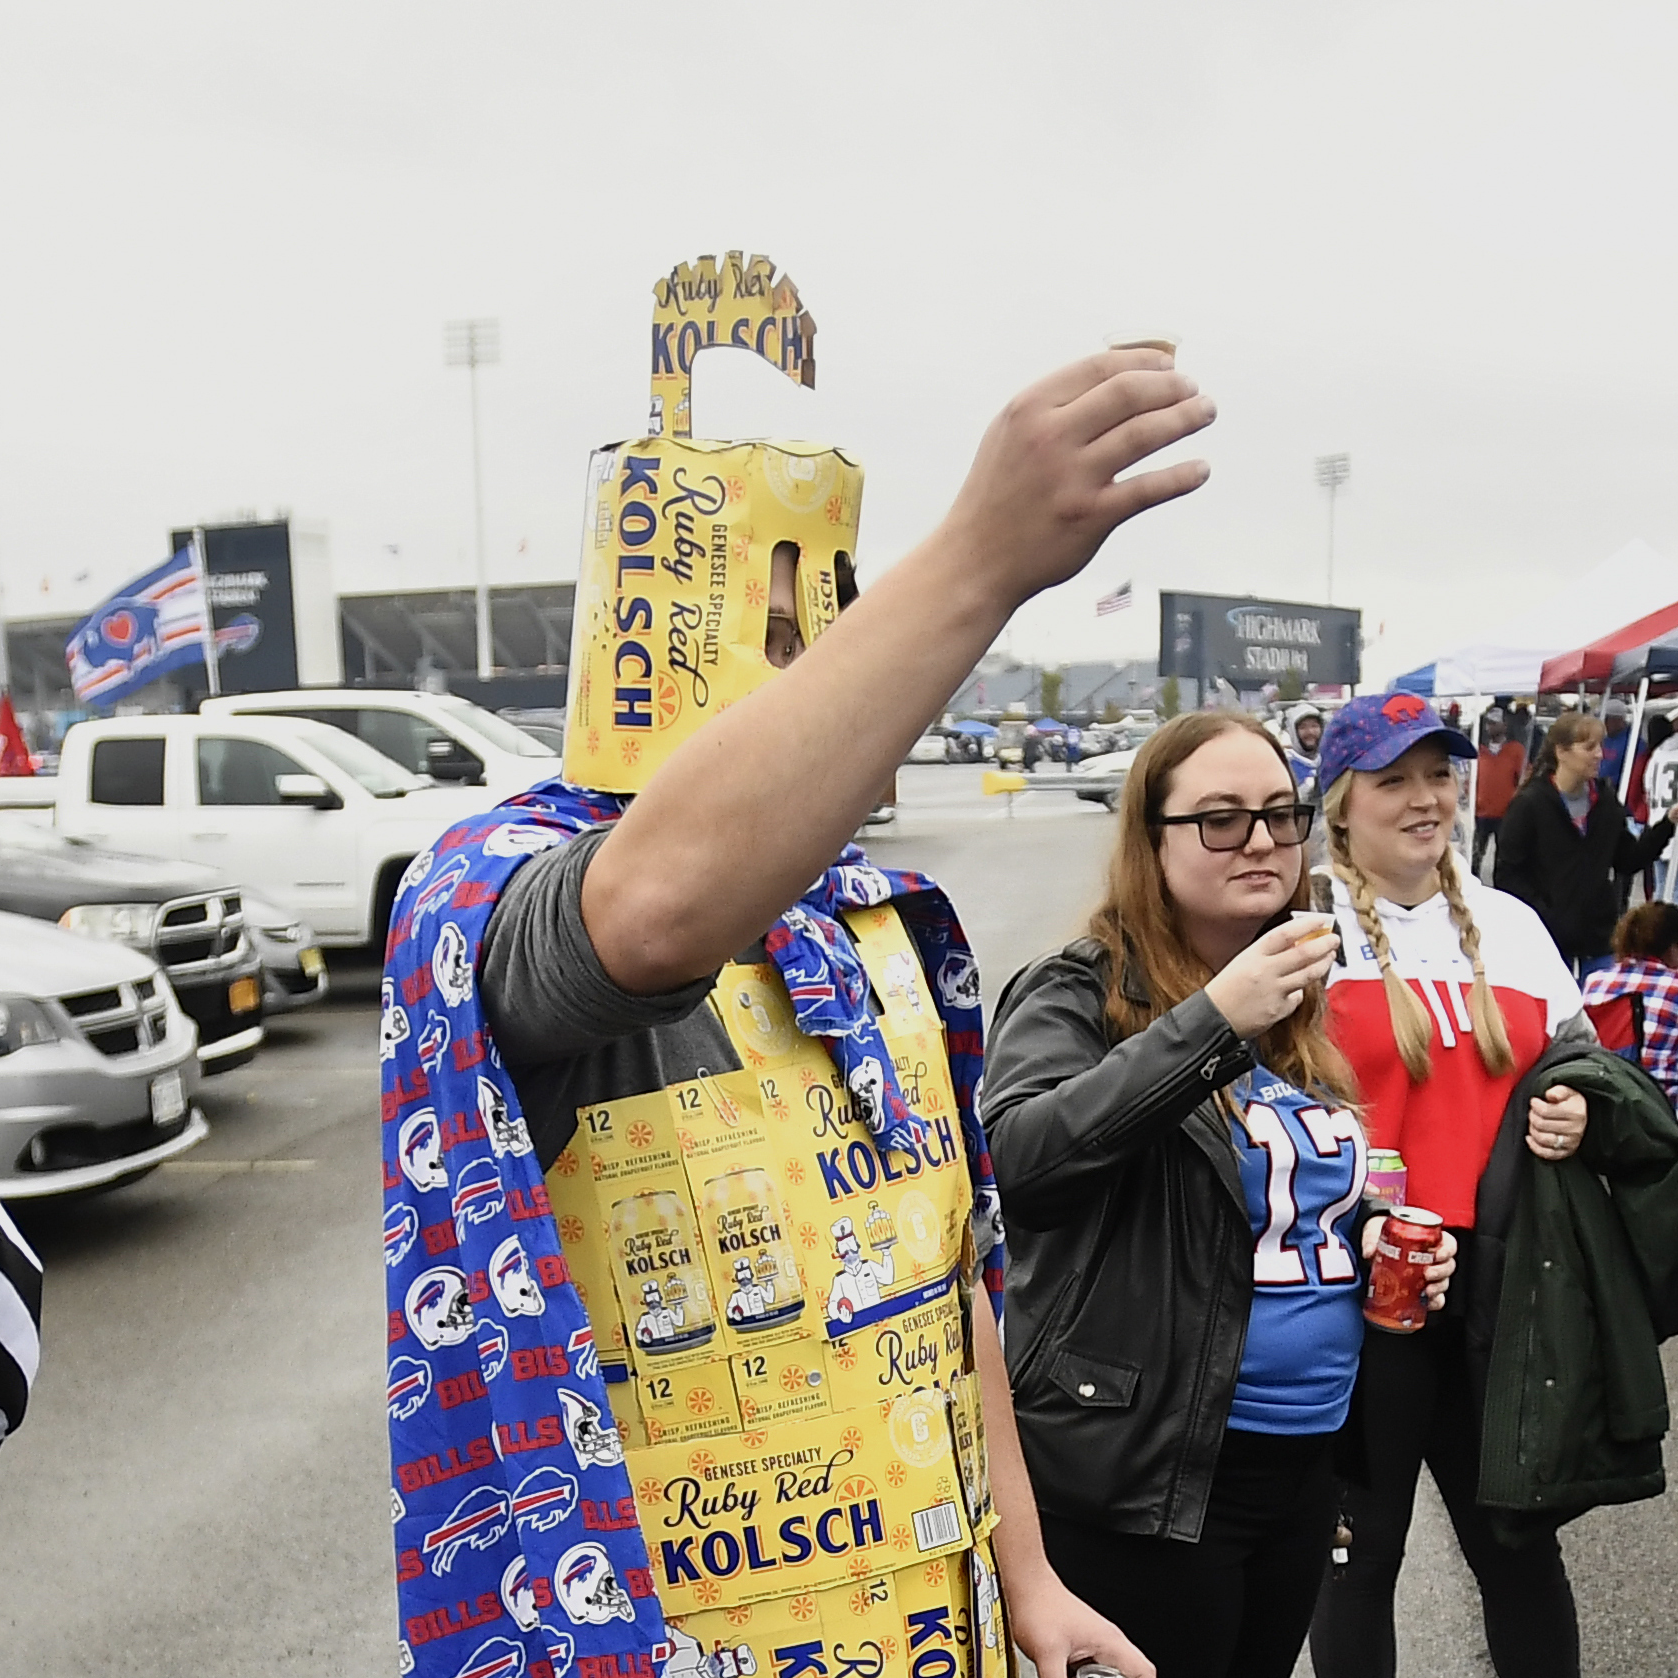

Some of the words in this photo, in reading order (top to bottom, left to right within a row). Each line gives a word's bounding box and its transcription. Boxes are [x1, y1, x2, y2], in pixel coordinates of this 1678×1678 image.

[657, 266, 719, 316] Ruby
[661, 467, 727, 586] Ruby
[710, 524, 728, 589] GENESEE
[613, 456, 661, 731] KOLSCH
[703, 594, 725, 666] SPECIALTY
[1235, 613, 1321, 645] HIGHMARK
[667, 600, 710, 708] Red
[1245, 646, 1309, 673] STADIUM
[676, 1088, 702, 1110] 12
[760, 1079, 779, 1099] 12
[586, 1110, 612, 1133] 12
[625, 1151, 671, 1166] REFRESHING
[1246, 1101, 1368, 1284] 17
[717, 1214, 744, 1234] Ruby
[747, 1204, 770, 1224] Red
[624, 1237, 651, 1257] Ruby
[656, 1229, 679, 1246] Red
[717, 1223, 782, 1255] KOLSCH
[625, 1247, 692, 1277] KOLSCH
[902, 1313, 936, 1335] GENESEE
[742, 1356, 768, 1379] 12
[876, 1329, 940, 1386] Ruby
[646, 1378, 673, 1401] 12
[777, 1393, 821, 1409] REFRESHING
[685, 1416, 731, 1433] REFRESHING
[397, 1436, 495, 1493] BILLS
[704, 1460, 759, 1482] GENESEE
[762, 1447, 822, 1472] SPECIALTY
[663, 1476, 762, 1529] Ruby
[774, 1449, 854, 1504] Red
[660, 1498, 887, 1588] KOLSCH
[868, 1579, 889, 1603] 12
[405, 1591, 504, 1647] BILLS
